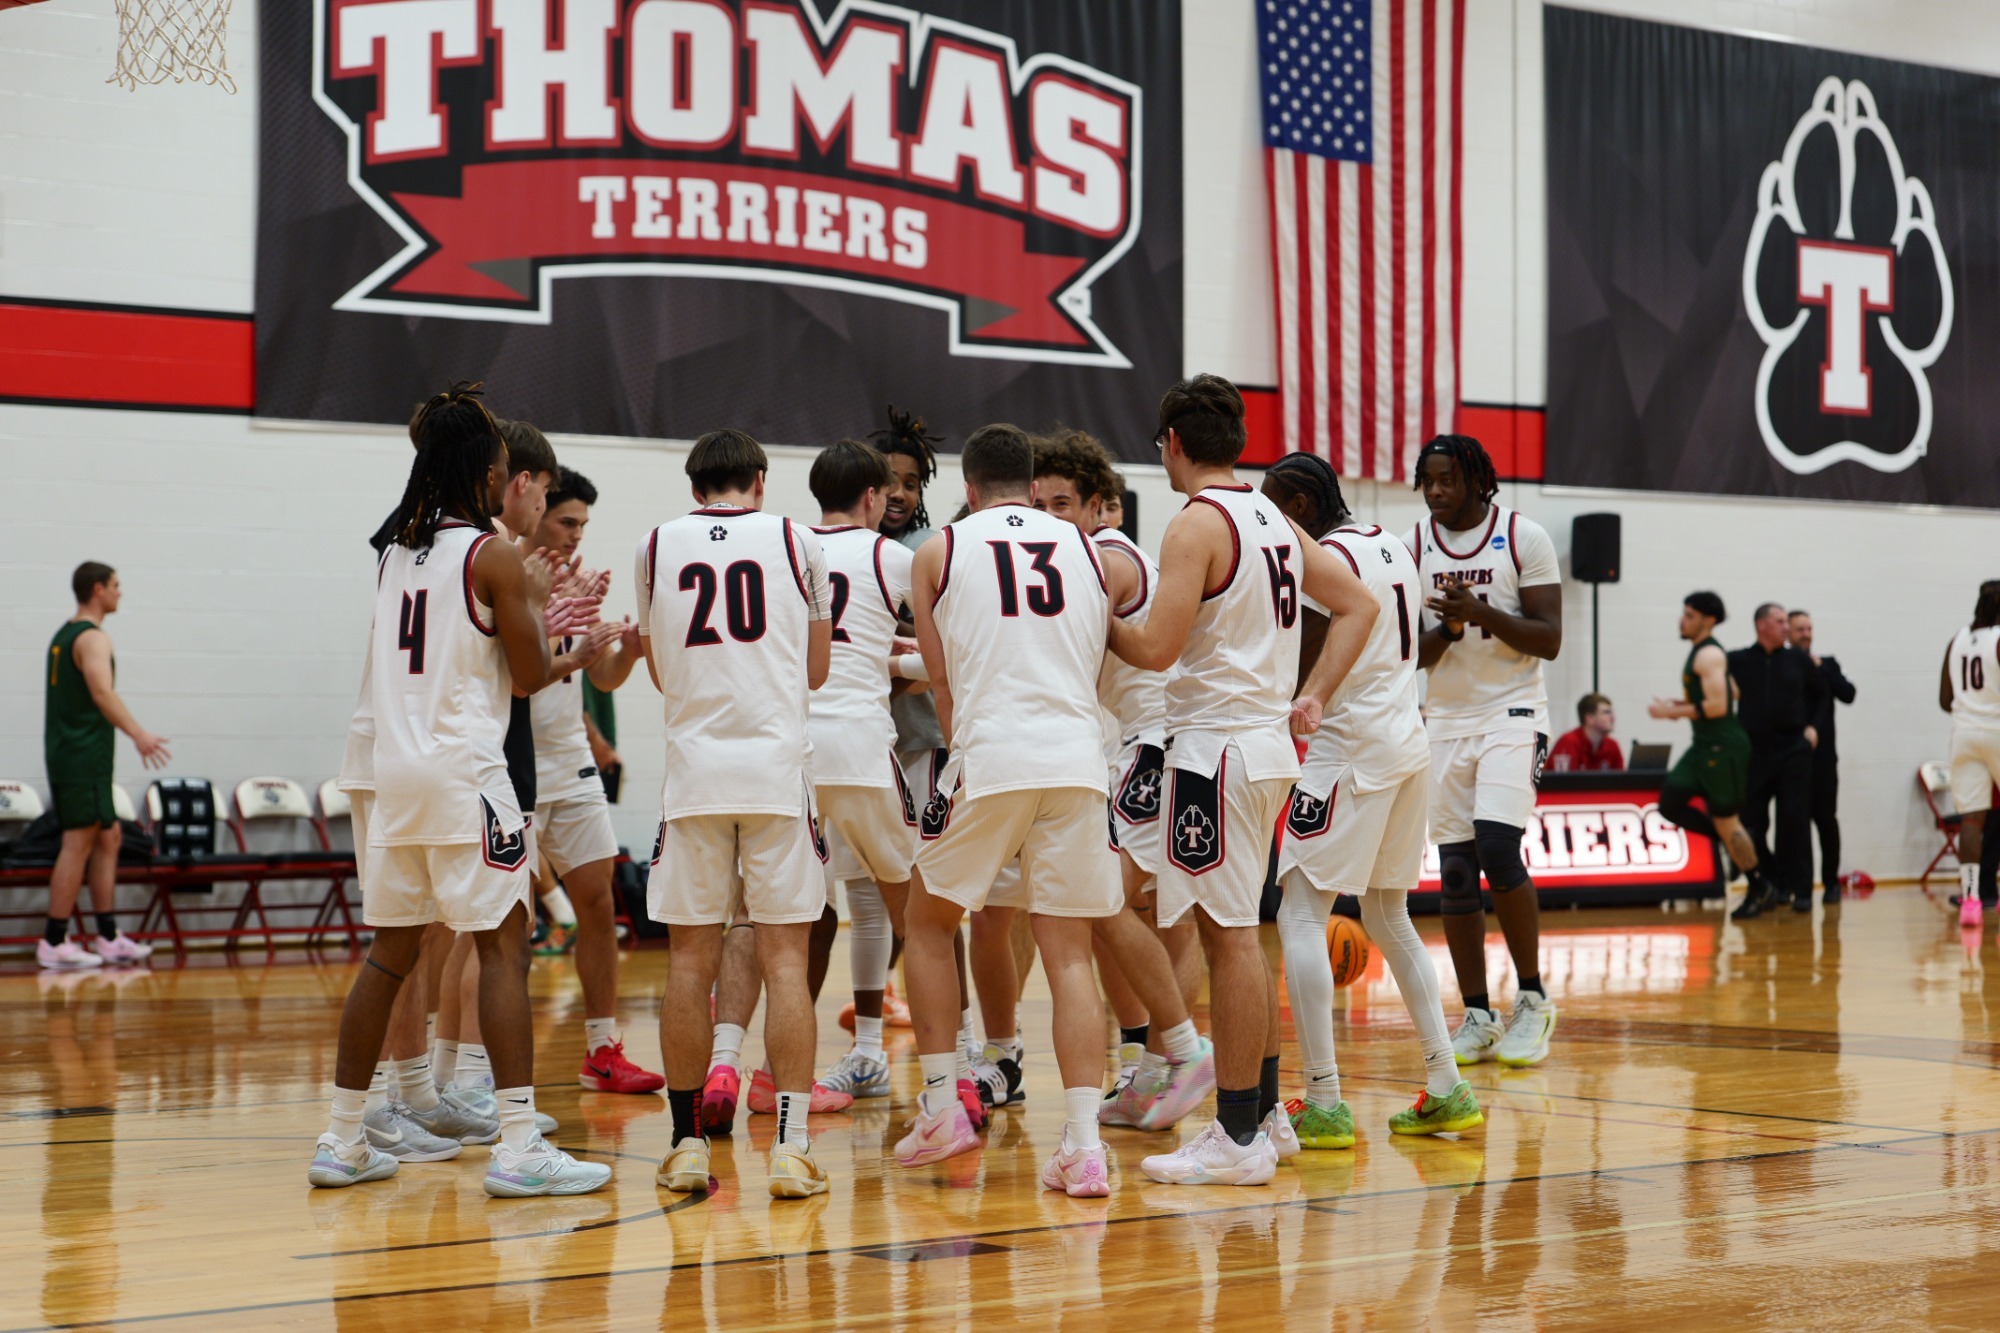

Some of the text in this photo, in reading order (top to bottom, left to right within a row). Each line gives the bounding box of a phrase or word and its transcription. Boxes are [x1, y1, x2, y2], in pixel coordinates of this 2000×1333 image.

[331, 0, 1126, 238] THOMAS
[579, 175, 929, 269] TERRIERS
[1798, 241, 1892, 414] T
[679, 559, 767, 648] 20
[985, 540, 1065, 617] 13
[1260, 544, 1297, 630] 15
[1391, 582, 1412, 662] 1
[398, 588, 429, 675] 4
[1961, 655, 1984, 692] 10
